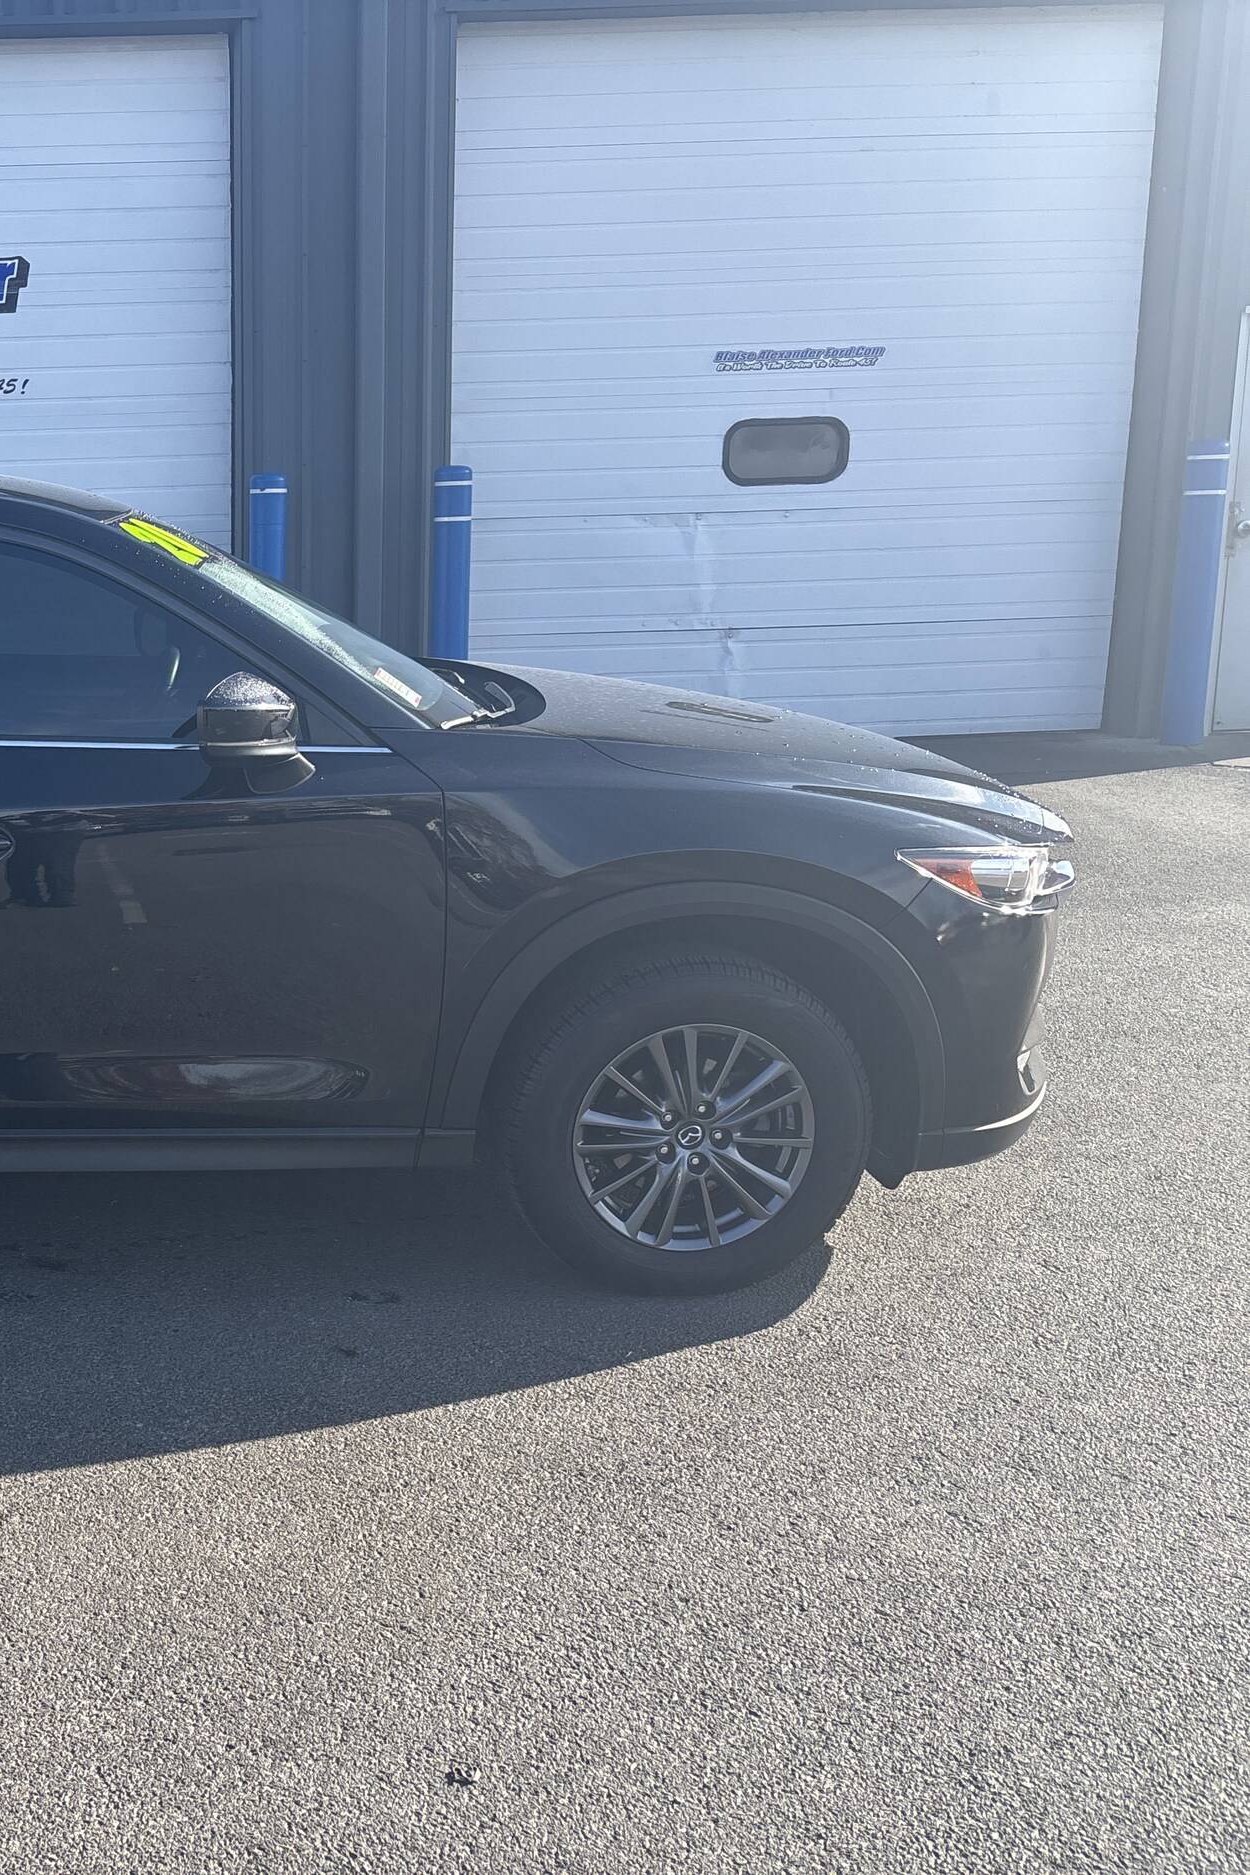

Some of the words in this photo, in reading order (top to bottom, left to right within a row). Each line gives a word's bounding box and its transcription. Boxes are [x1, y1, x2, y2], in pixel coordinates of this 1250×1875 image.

[732, 362, 763, 371] Worth
[765, 361, 783, 370] The
[784, 360, 813, 370] Drive
[813, 359, 828, 368] To
[828, 358, 857, 368] Route
